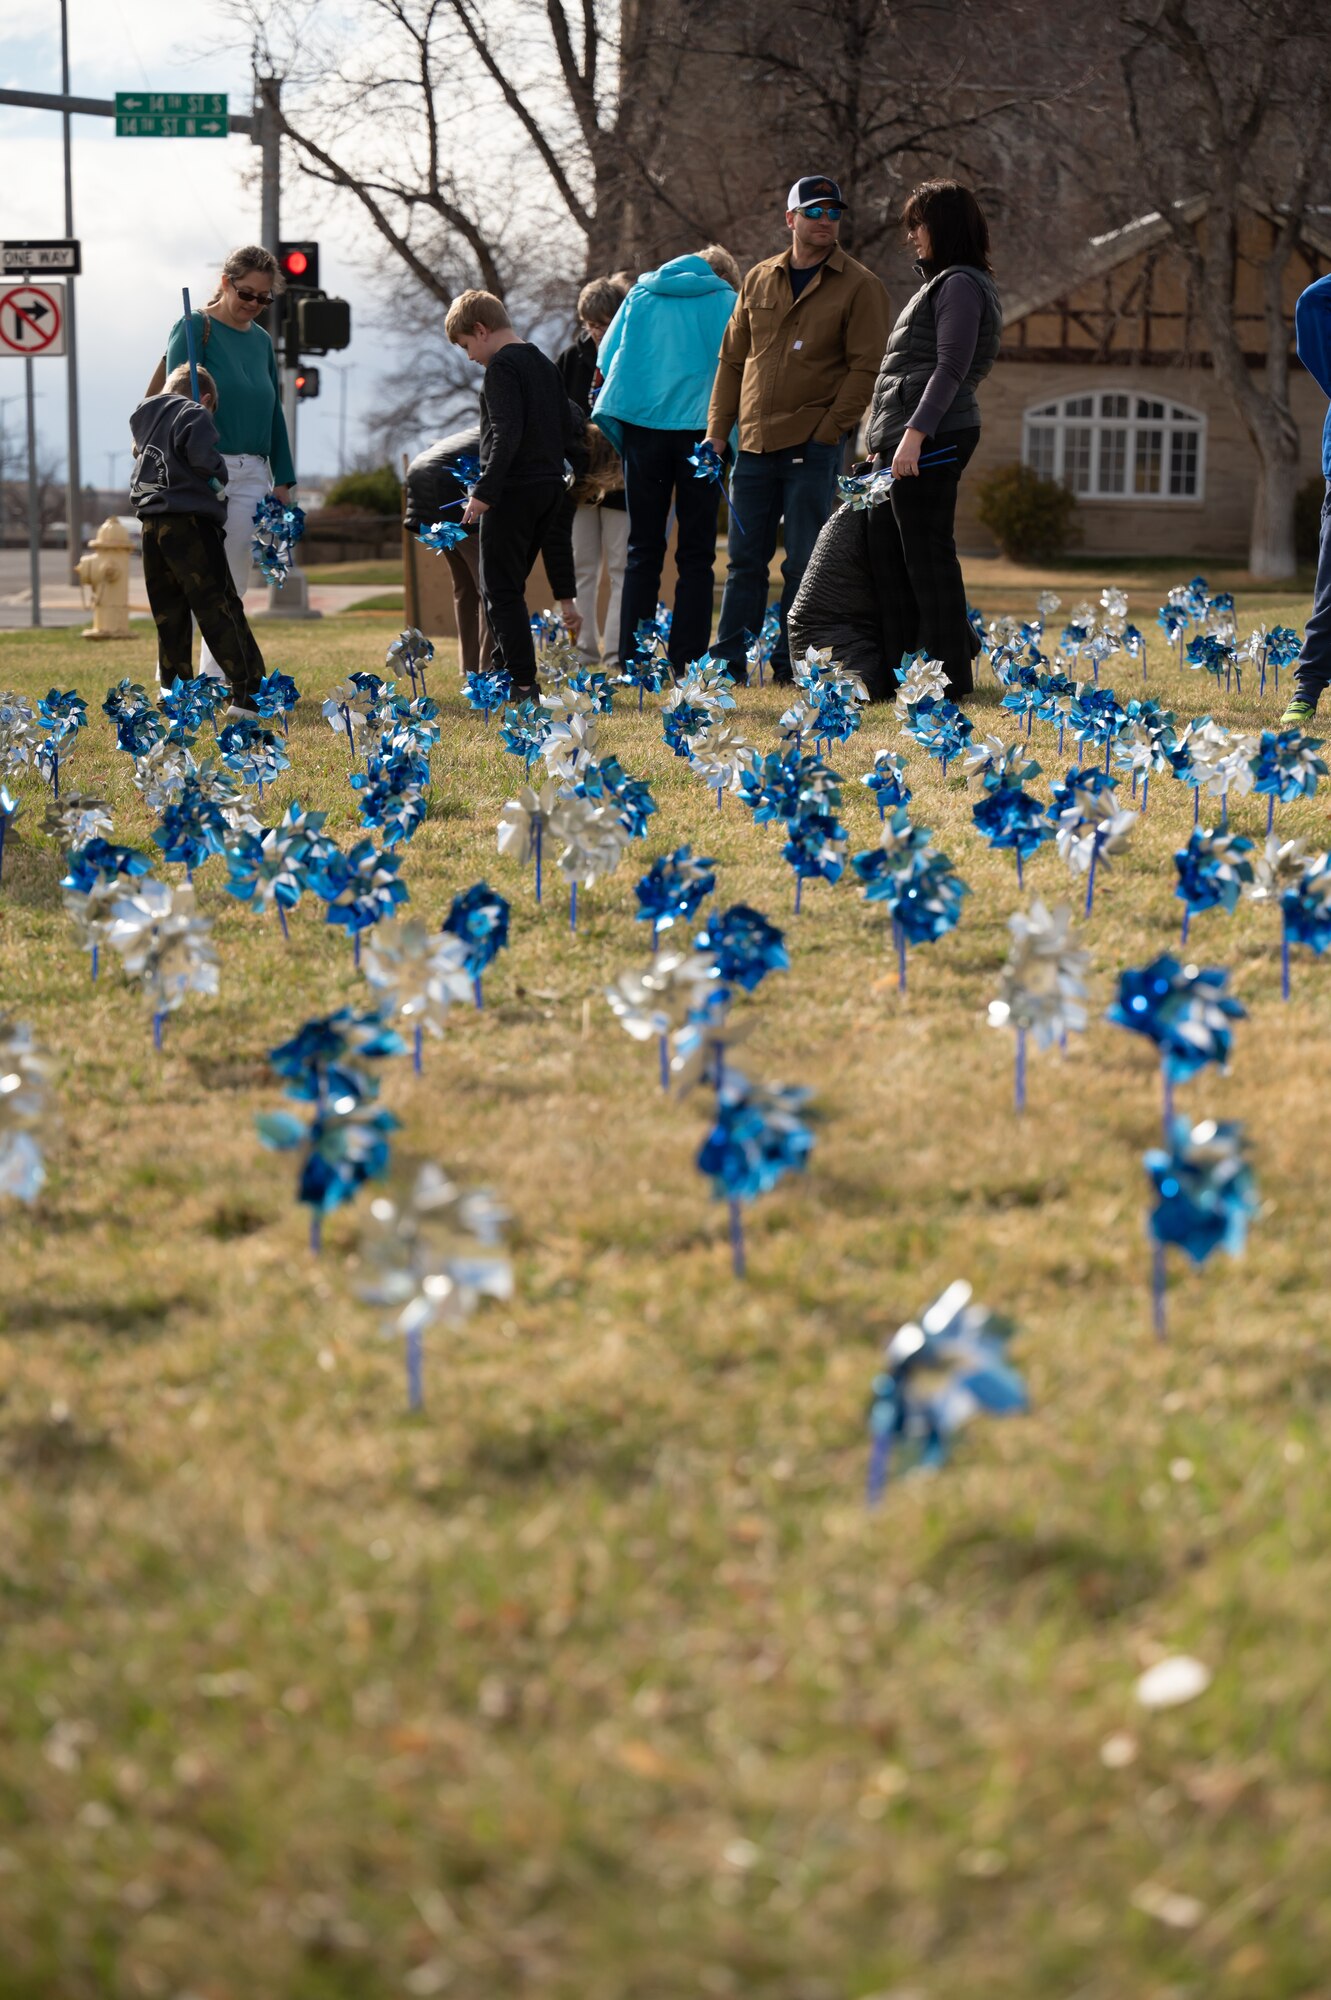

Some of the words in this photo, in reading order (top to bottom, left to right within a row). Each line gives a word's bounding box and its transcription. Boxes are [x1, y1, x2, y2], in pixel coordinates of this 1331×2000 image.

[188, 96, 204, 113] ST
[212, 96, 221, 113] S
[161, 118, 178, 135] ST
[3, 251, 33, 265] ONE
[39, 251, 69, 264] WAY
